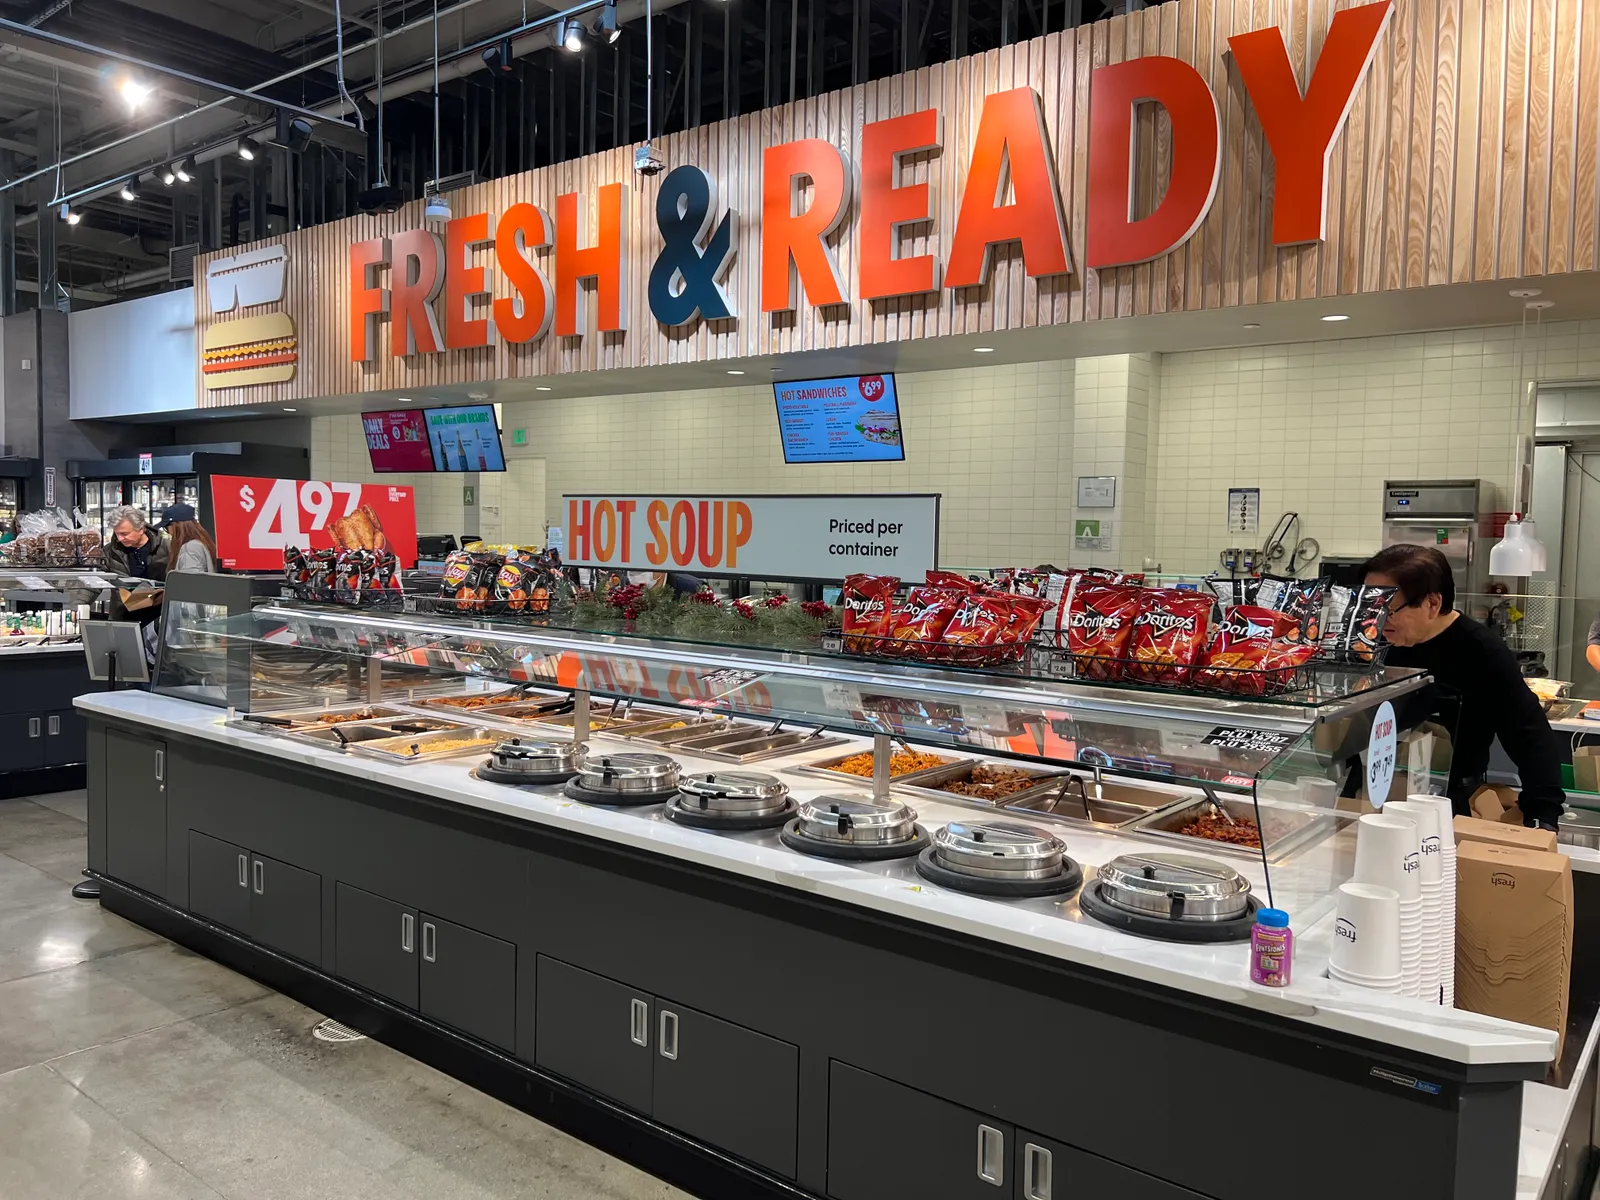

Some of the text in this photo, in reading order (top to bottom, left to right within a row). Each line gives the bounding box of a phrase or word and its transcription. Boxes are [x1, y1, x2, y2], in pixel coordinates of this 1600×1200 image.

[350, 0, 1395, 362] FRESH & READY
[781, 386, 847, 401] HOT SANDWICHES
[363, 418, 385, 434] DAILY
[430, 414, 443, 426] SAVE
[467, 411, 490, 424] BRANDS
[366, 434, 390, 450] DEALS
[464, 490, 472, 502] A
[568, 499, 753, 568] HOT SOUP
[829, 518, 904, 538] Priced per
[1082, 526, 1093, 537] A
[828, 541, 899, 557] container
[845, 596, 884, 611] Doritos
[1071, 614, 1122, 630] Doritos
[1138, 611, 1195, 630] Doritos
[1219, 730, 1247, 738] PLU
[1210, 739, 1239, 748] PLU
[1225, 776, 1250, 785] HOT
[1491, 877, 1516, 889] fresh
